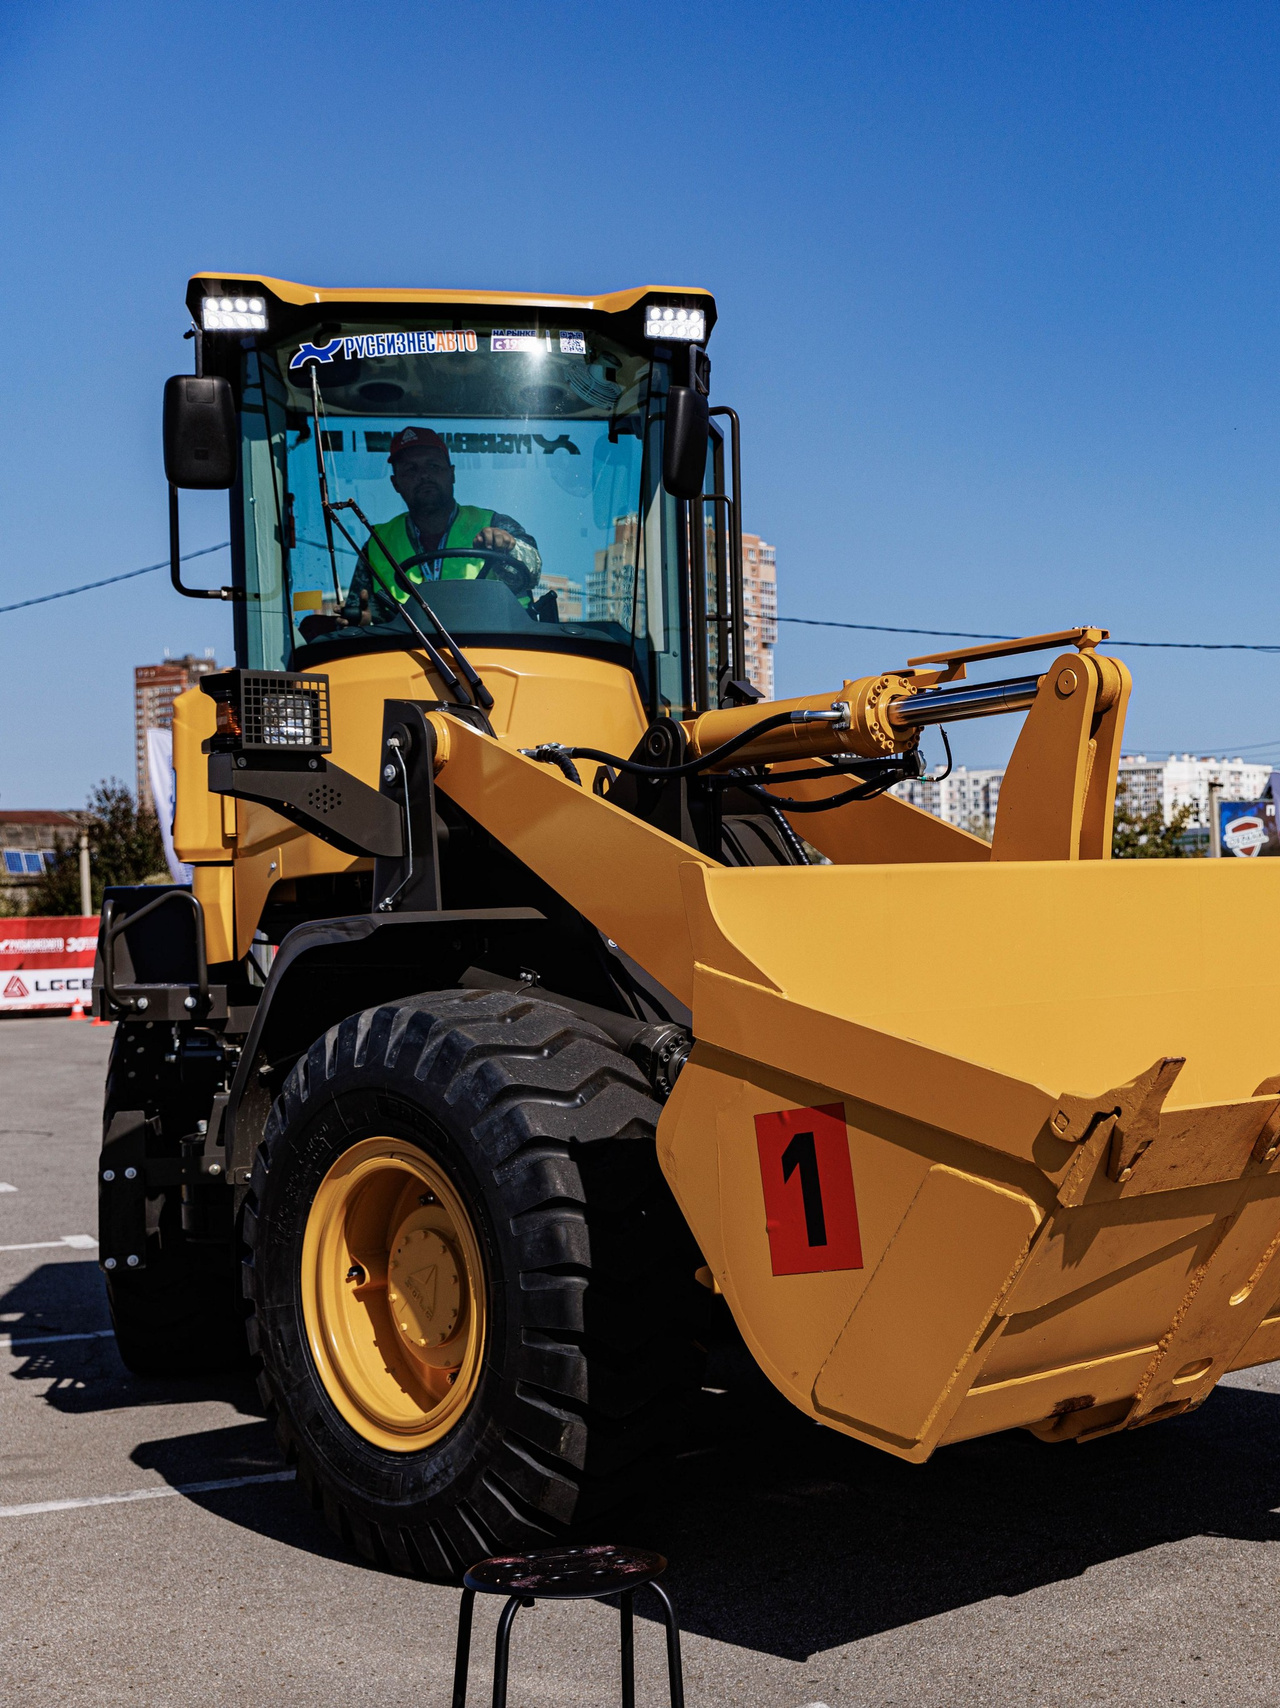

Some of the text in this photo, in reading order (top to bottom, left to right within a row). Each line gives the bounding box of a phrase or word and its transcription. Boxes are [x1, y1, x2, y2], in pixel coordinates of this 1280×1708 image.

[344, 330, 478, 360] РУСБИЗНЕСАВТО
[493, 329, 537, 337] НА РЫНКЕ
[781, 1131, 827, 1247] 1
